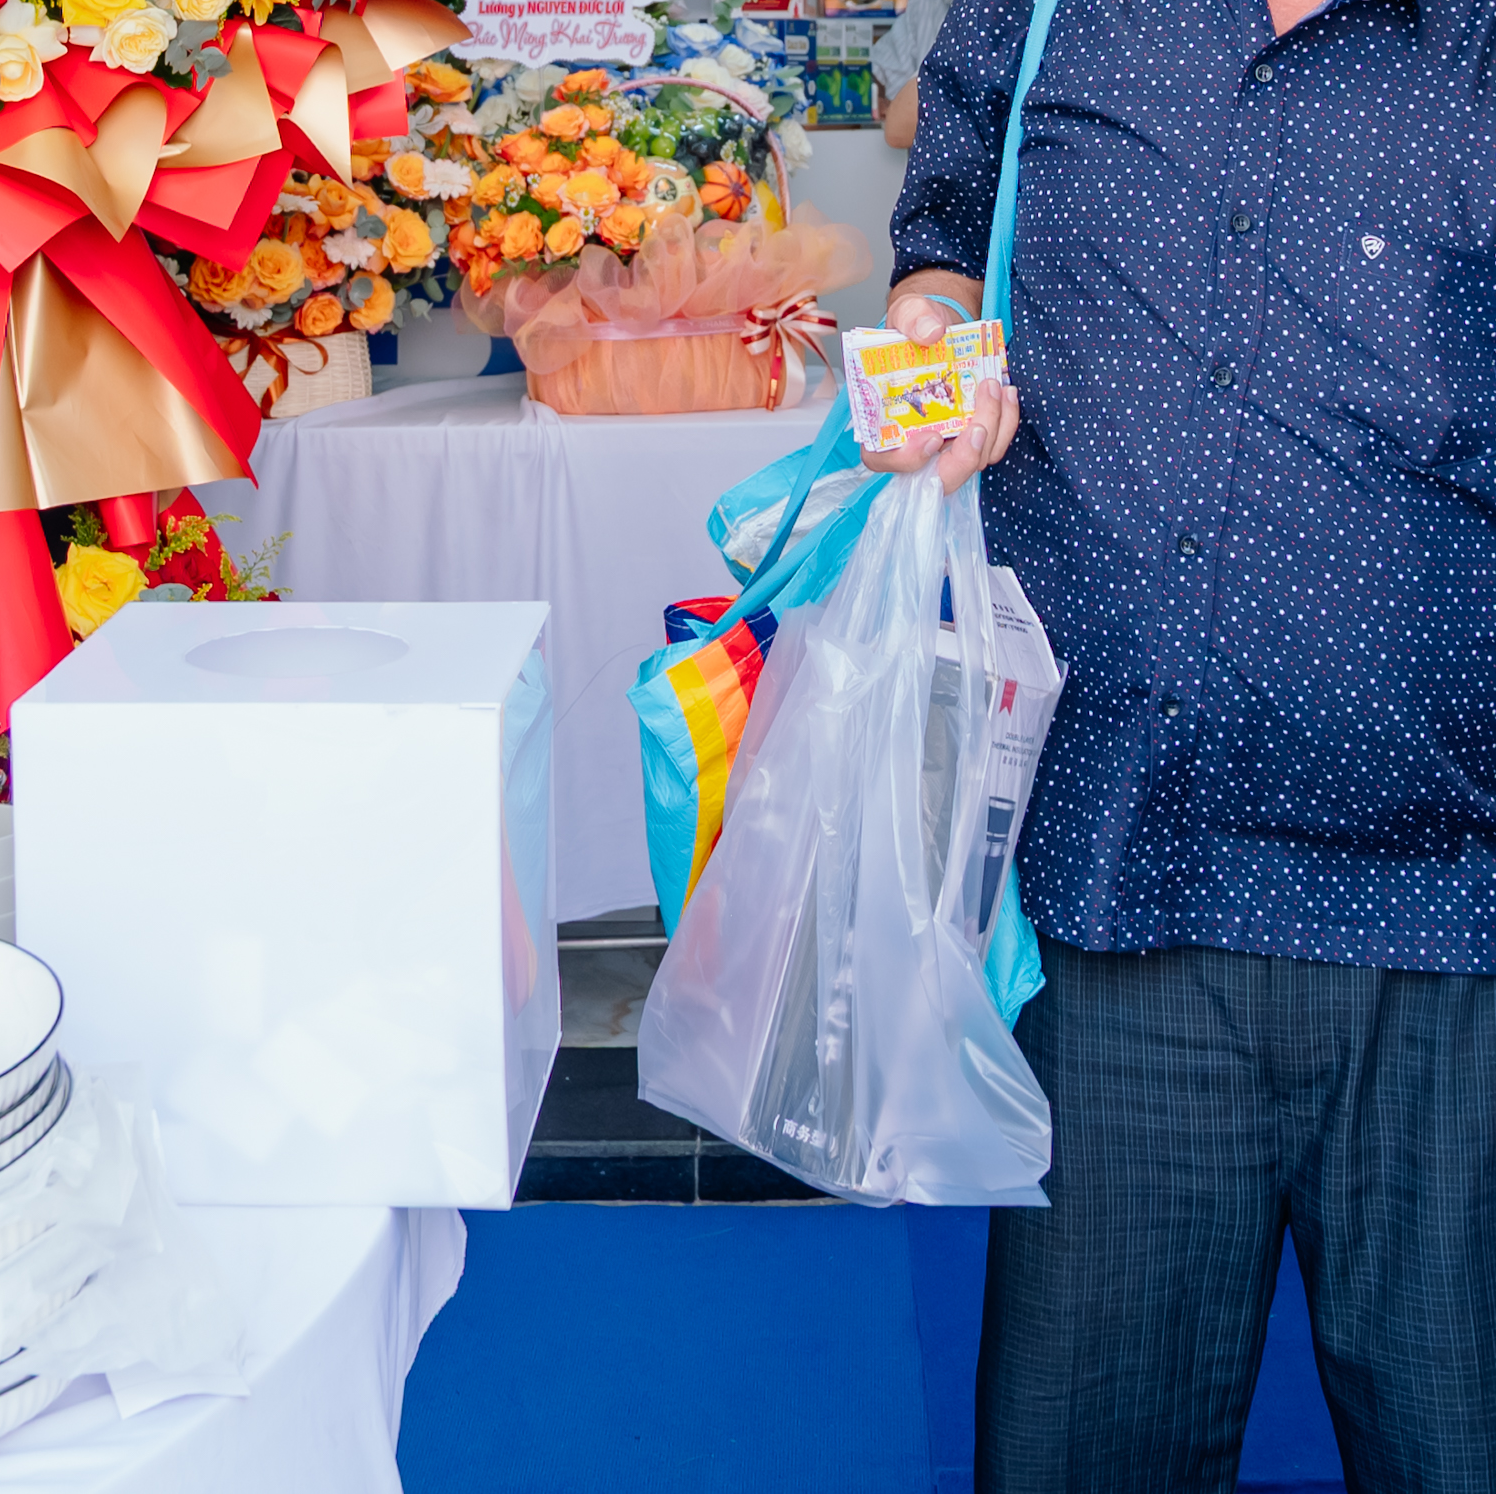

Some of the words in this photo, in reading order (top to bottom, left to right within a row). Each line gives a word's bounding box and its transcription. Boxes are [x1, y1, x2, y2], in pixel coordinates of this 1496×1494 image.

[478, 0, 515, 18] Lương
[517, 4, 525, 18] y
[459, 20, 497, 47] Chúc
[499, 18, 548, 59] Mừng
[549, 17, 593, 48] Khai
[593, 17, 646, 58] Trương
